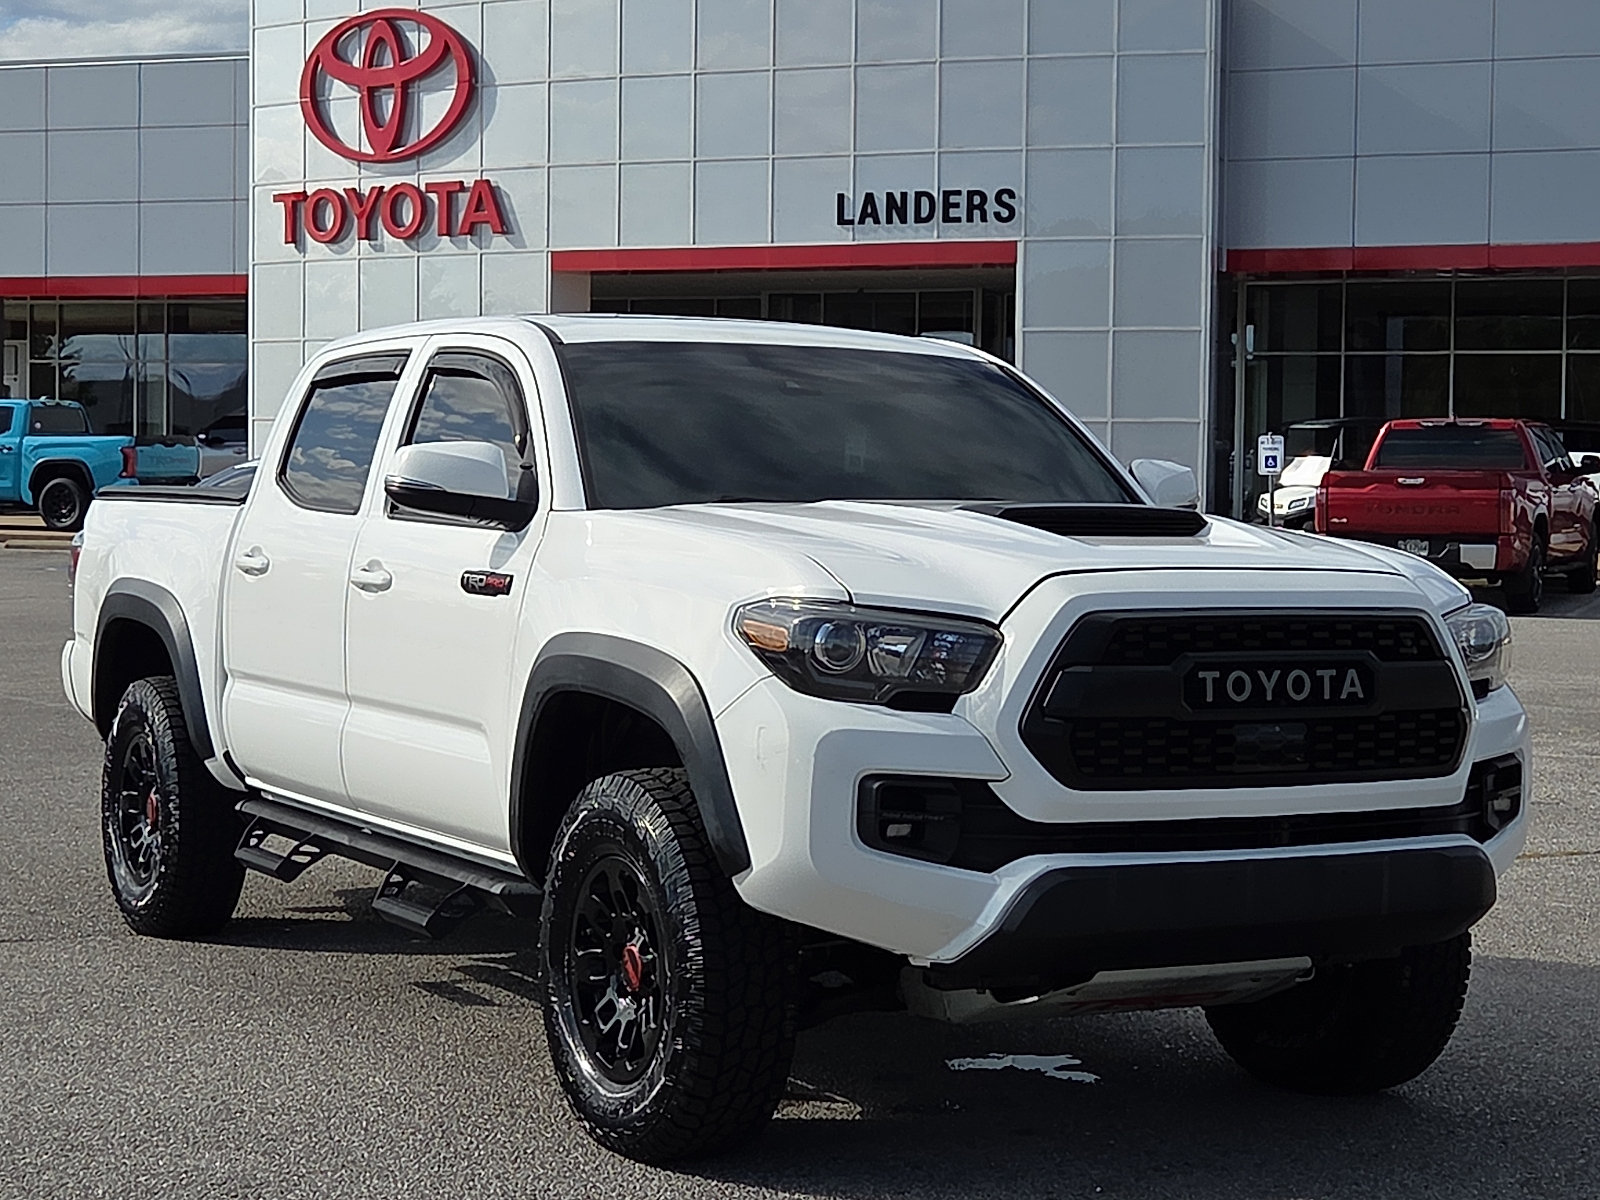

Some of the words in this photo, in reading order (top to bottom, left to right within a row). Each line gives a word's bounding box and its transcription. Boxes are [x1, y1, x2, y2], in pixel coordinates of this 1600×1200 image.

[273, 179, 508, 244] TOYOTA
[836, 188, 1016, 226] LANDERS
[463, 573, 487, 591] TRD
[1198, 668, 1364, 702] TOYOTA
